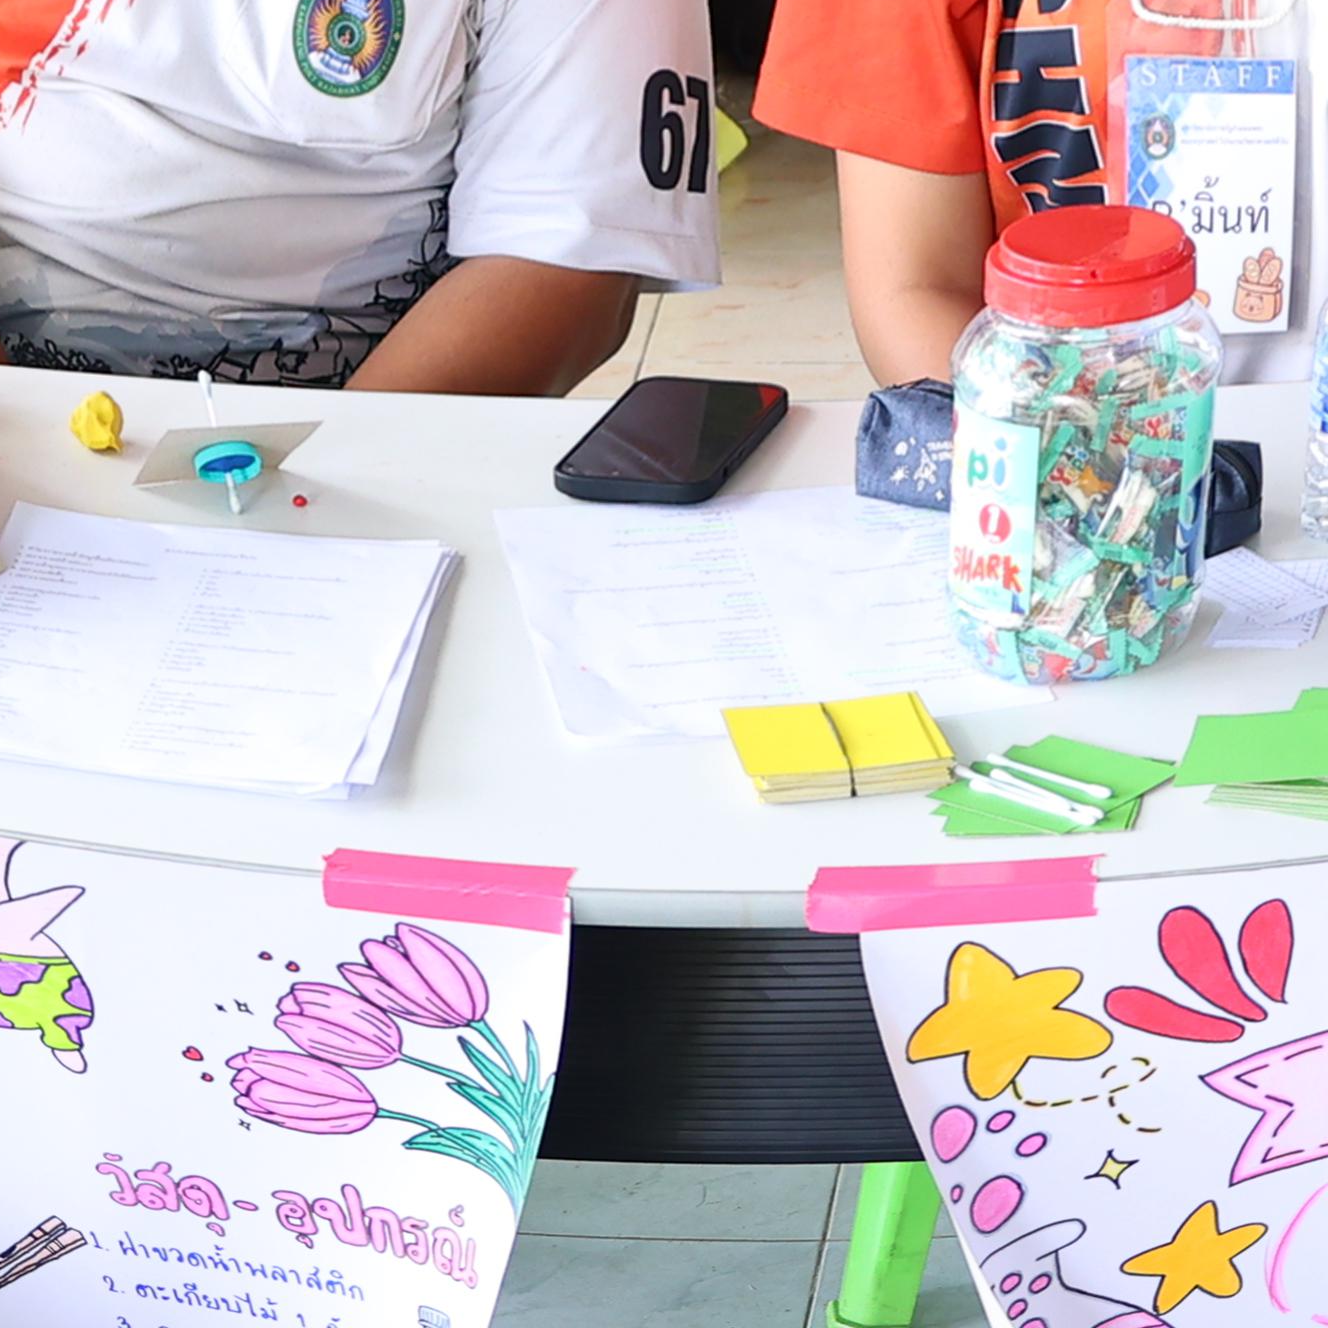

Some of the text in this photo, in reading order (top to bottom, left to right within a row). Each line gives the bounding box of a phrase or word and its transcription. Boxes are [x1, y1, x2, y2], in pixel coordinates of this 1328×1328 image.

[1141, 63, 1282, 88] STAFF
[640, 68, 710, 194] 67
[271, 1183, 479, 1289] อุปกรณ์
